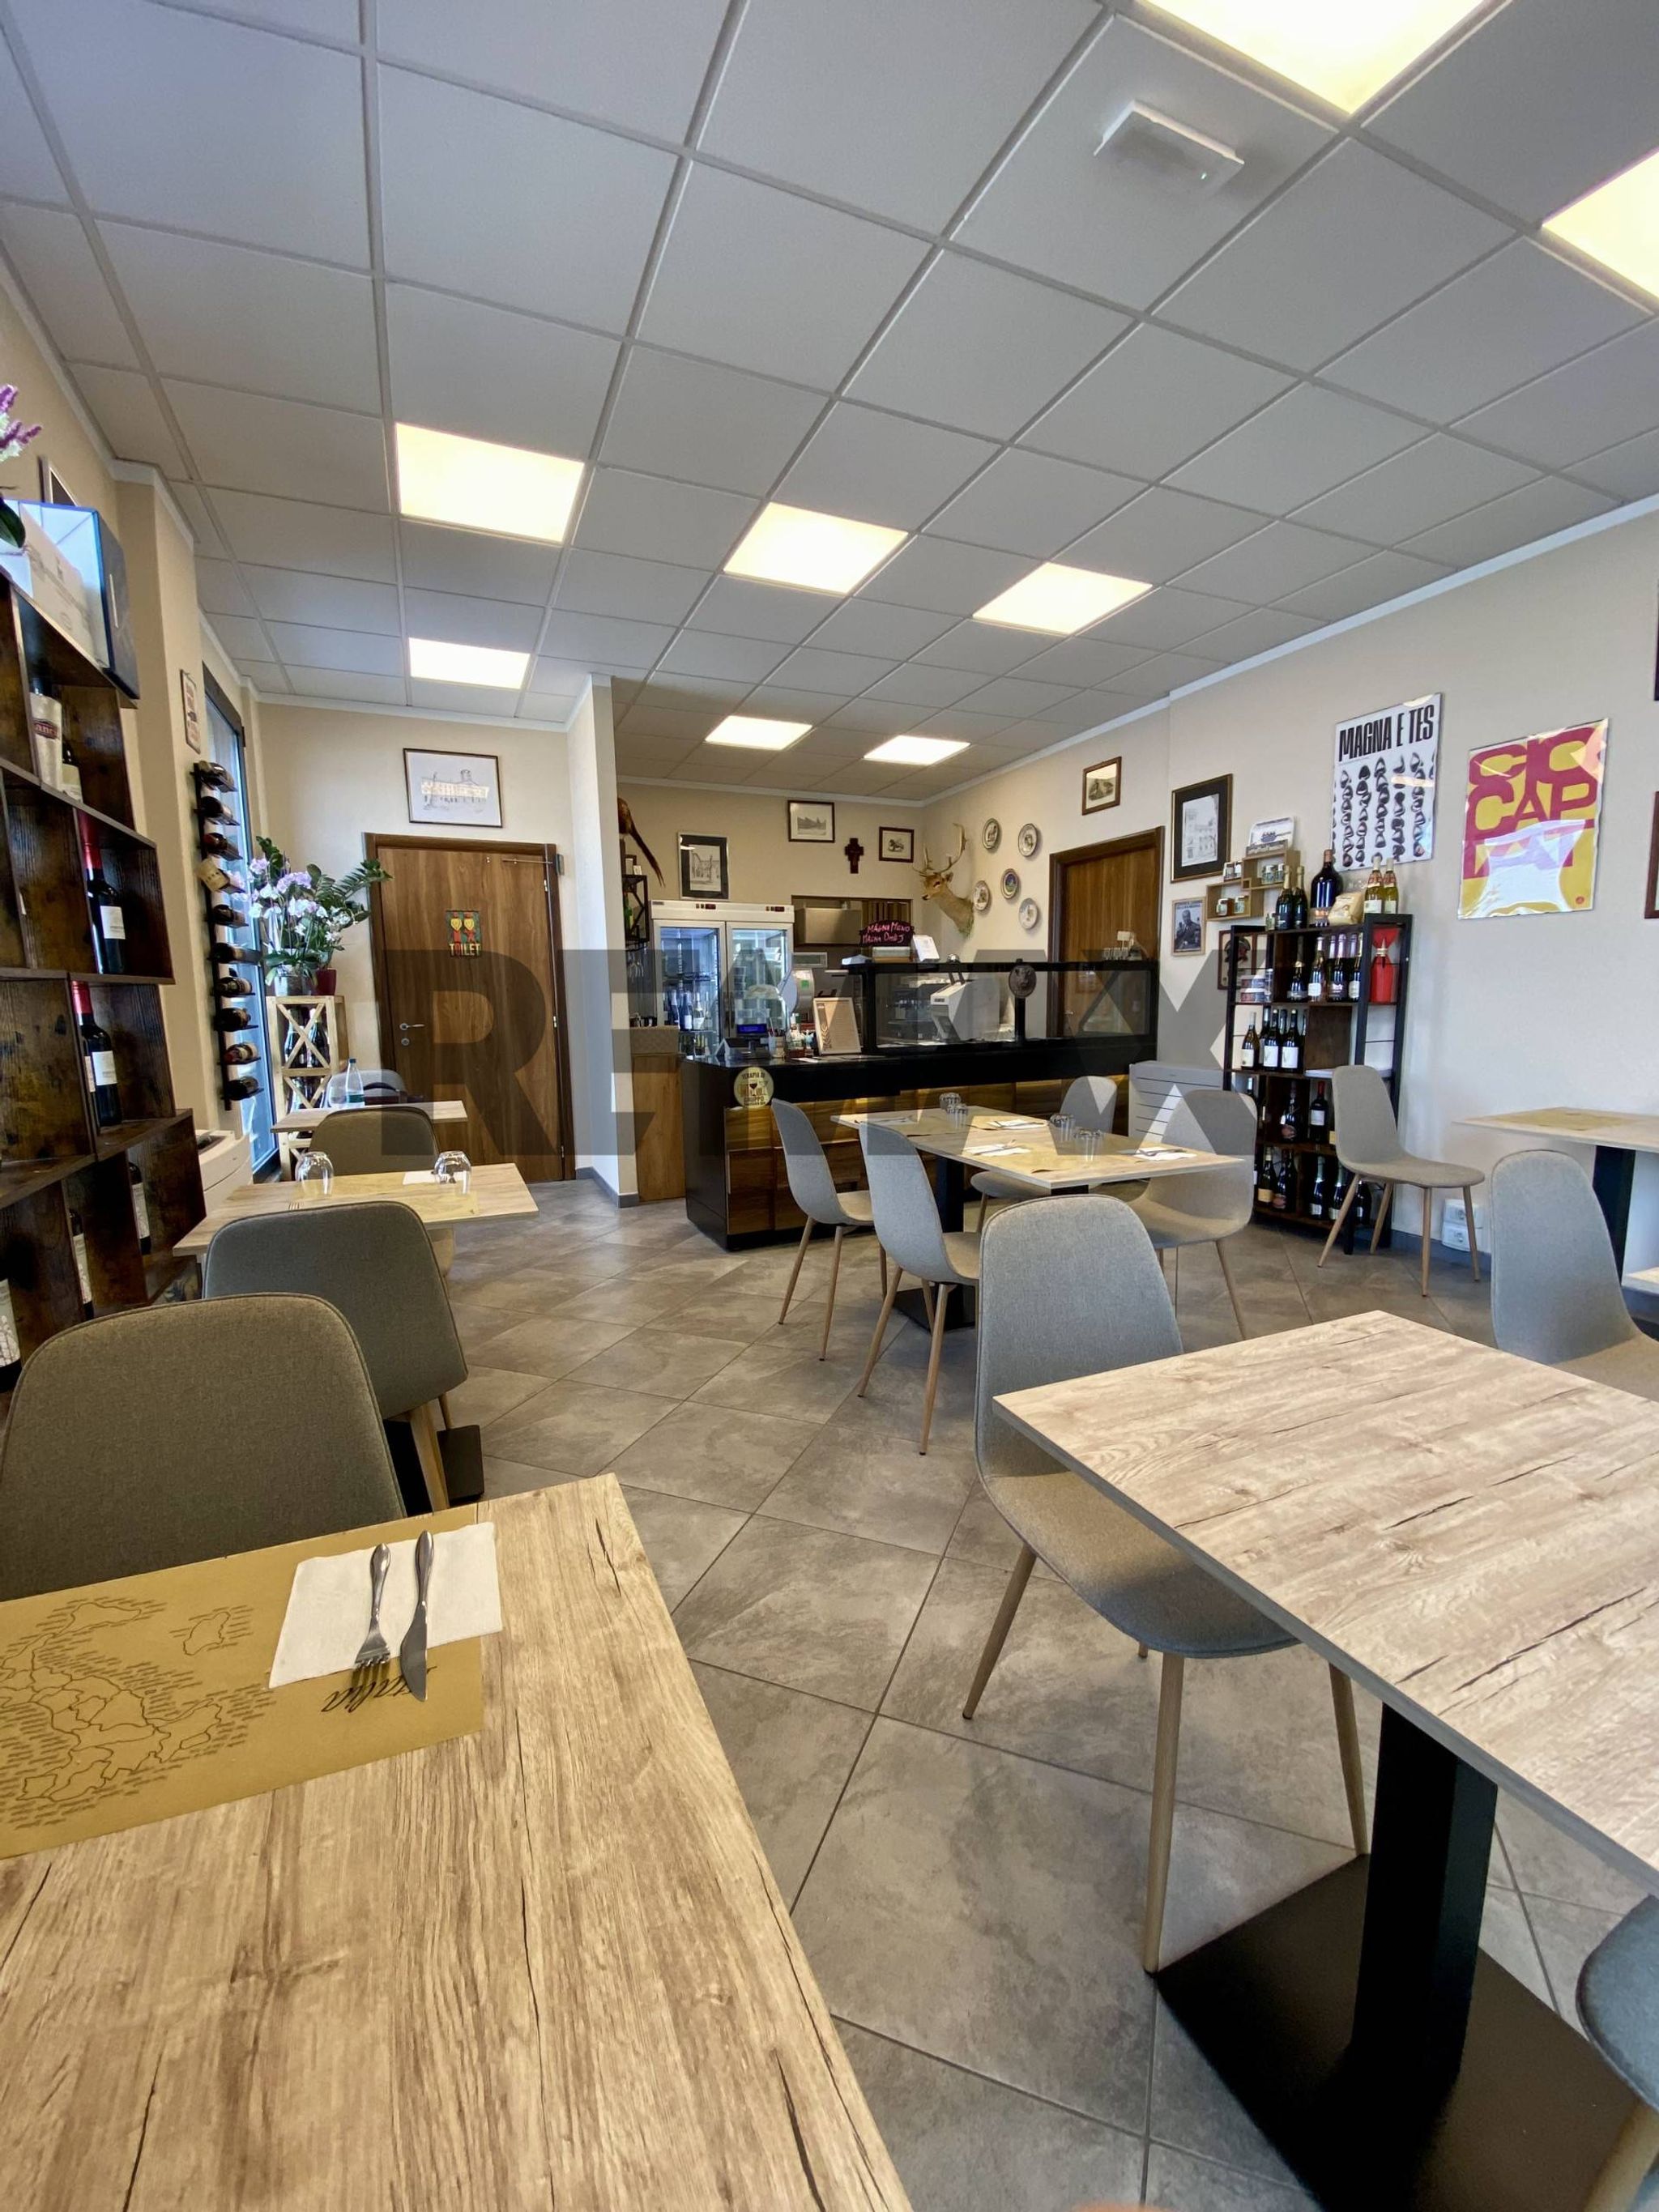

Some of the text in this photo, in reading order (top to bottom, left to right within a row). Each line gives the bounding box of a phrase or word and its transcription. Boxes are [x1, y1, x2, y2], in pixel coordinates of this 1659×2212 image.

[1338, 704, 1435, 762] MAGNA E TES
[449, 943, 481, 957] TOILET
[321, 1666, 437, 1714] talia
